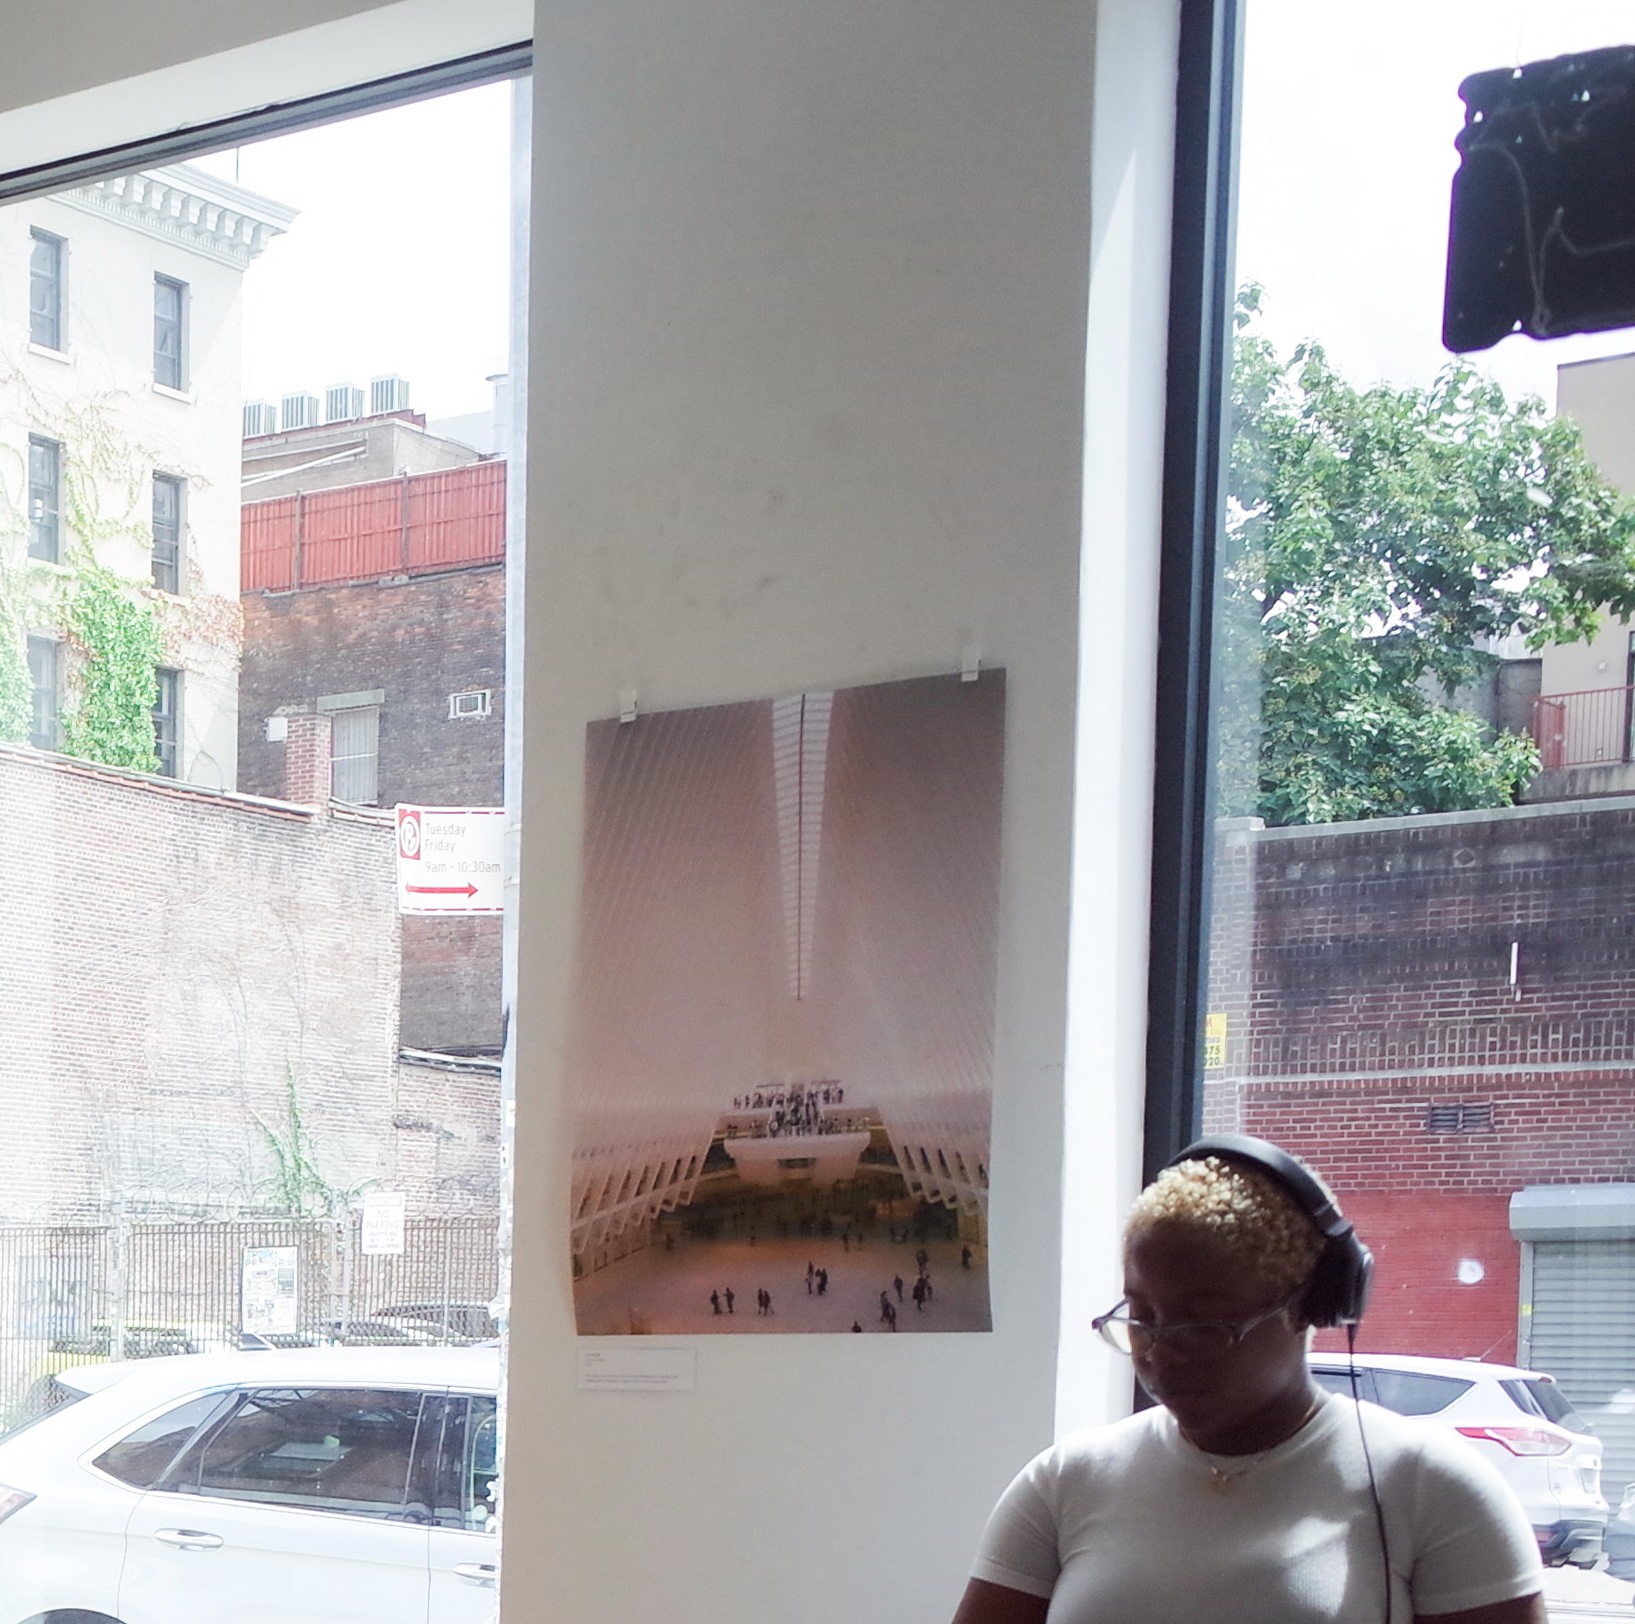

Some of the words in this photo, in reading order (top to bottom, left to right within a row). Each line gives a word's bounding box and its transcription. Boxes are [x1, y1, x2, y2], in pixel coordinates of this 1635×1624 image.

[425, 823, 466, 837] Tuesday
[425, 839, 456, 853] Friday
[425, 861, 447, 873] 9am
[457, 861, 501, 873] 10:30am
